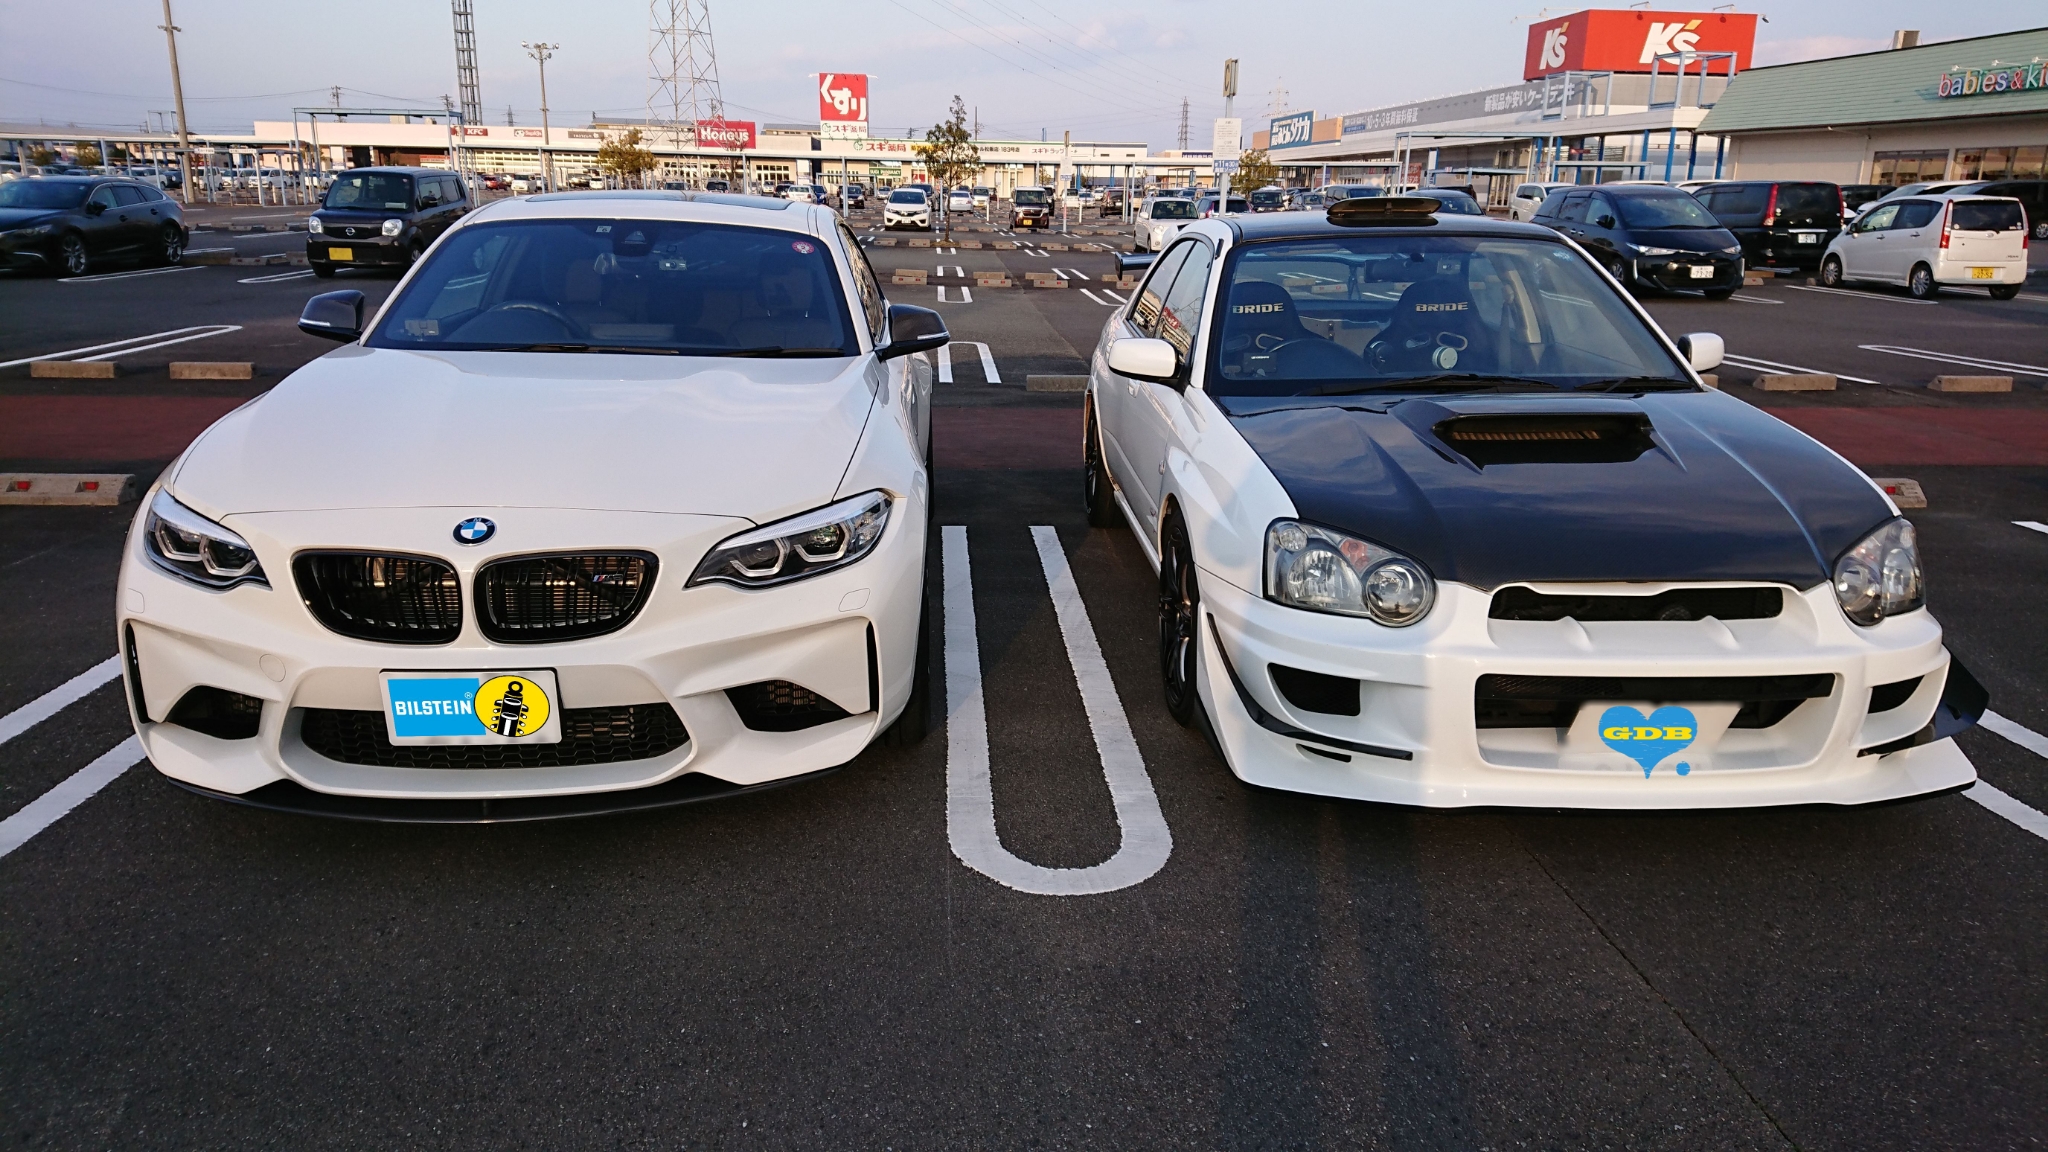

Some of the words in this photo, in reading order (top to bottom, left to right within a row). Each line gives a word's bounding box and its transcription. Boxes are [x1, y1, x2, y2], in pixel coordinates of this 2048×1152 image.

[1938, 62, 2048, 97] babies&ki
[820, 74, 867, 121] くすり
[1484, 82, 1576, 113] 新製品が安いケーデンキ
[700, 126, 749, 146] Honeys
[866, 140, 907, 152] スギ薬局
[1232, 302, 1285, 314] BRIDE
[1415, 301, 1468, 312] BRIDE
